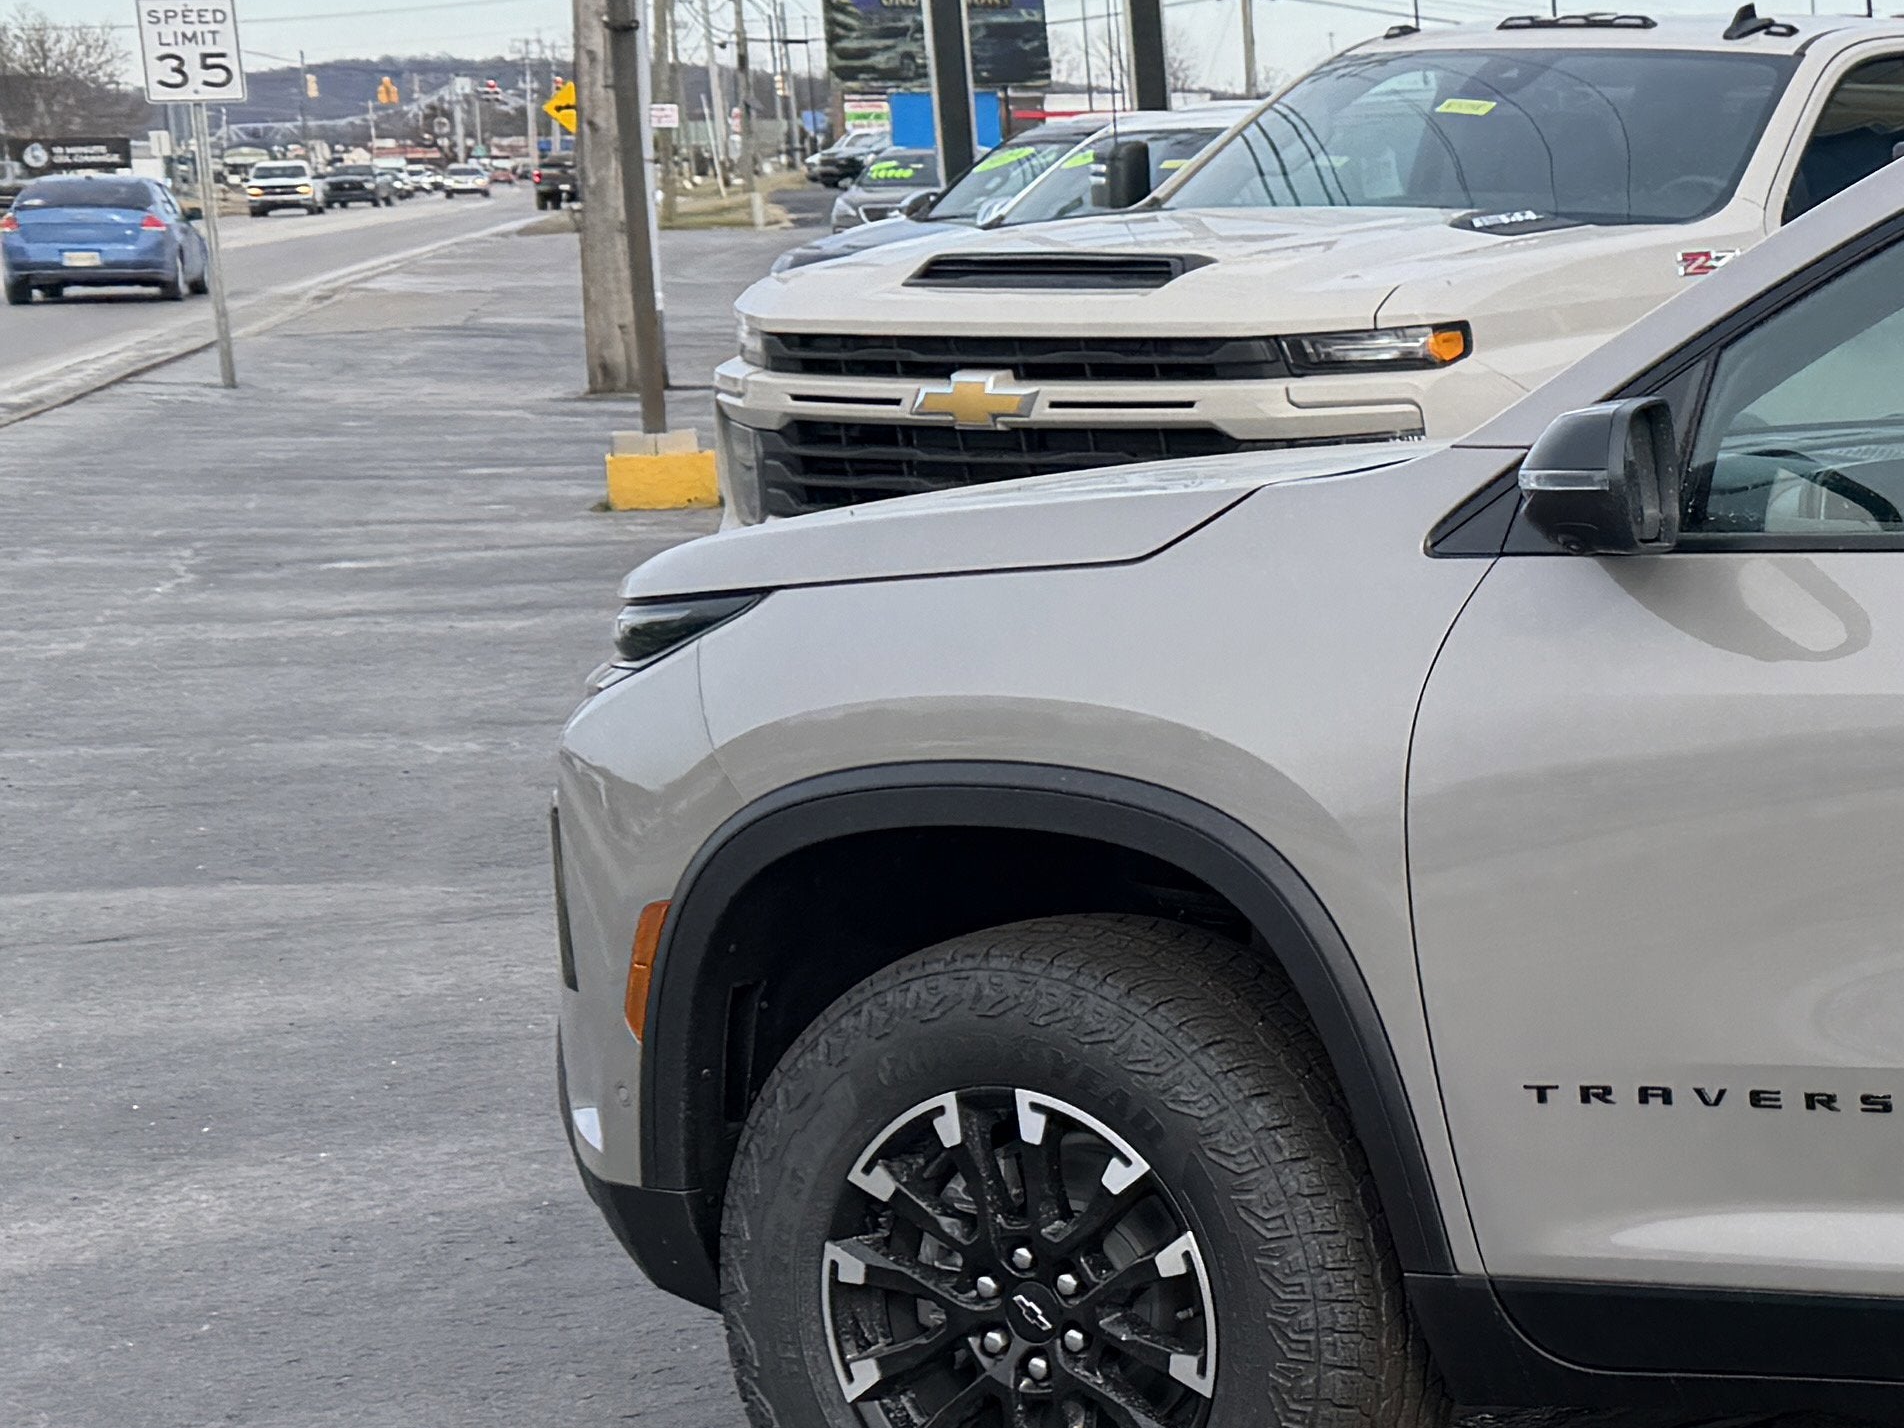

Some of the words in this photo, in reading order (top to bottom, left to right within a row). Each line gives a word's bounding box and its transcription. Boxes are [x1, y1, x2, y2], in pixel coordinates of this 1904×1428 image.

[146, 9, 227, 25] SPEED
[157, 30, 220, 46] LIMIT
[155, 53, 234, 89] 35
[1677, 249, 1741, 276] Z7
